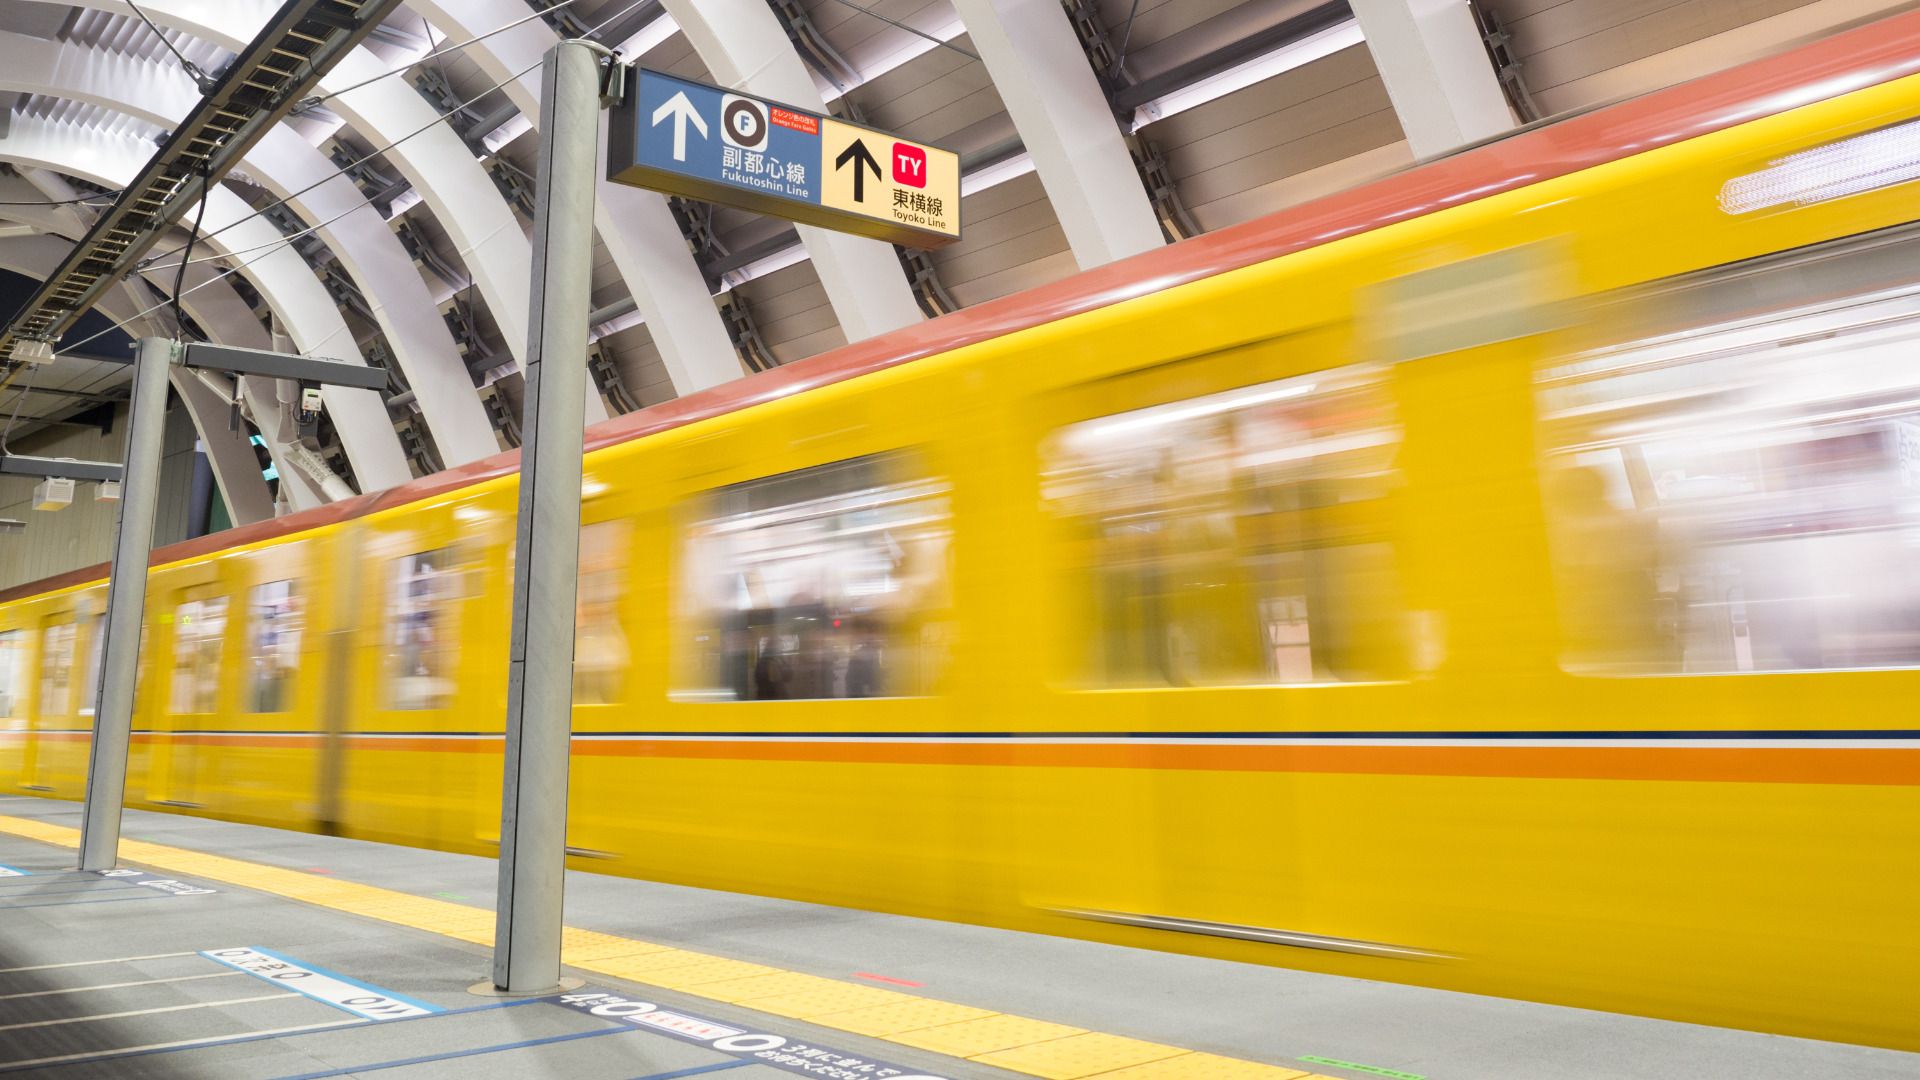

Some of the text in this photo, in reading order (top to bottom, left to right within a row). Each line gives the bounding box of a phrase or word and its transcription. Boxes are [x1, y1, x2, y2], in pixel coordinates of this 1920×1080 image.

[740, 115, 750, 131] F
[722, 146, 805, 184] 副都心線
[897, 154, 922, 177] TY
[722, 169, 809, 198] Fukutoshin Line
[893, 189, 943, 216] 東横線
[892, 209, 946, 229] Toyoko Line
